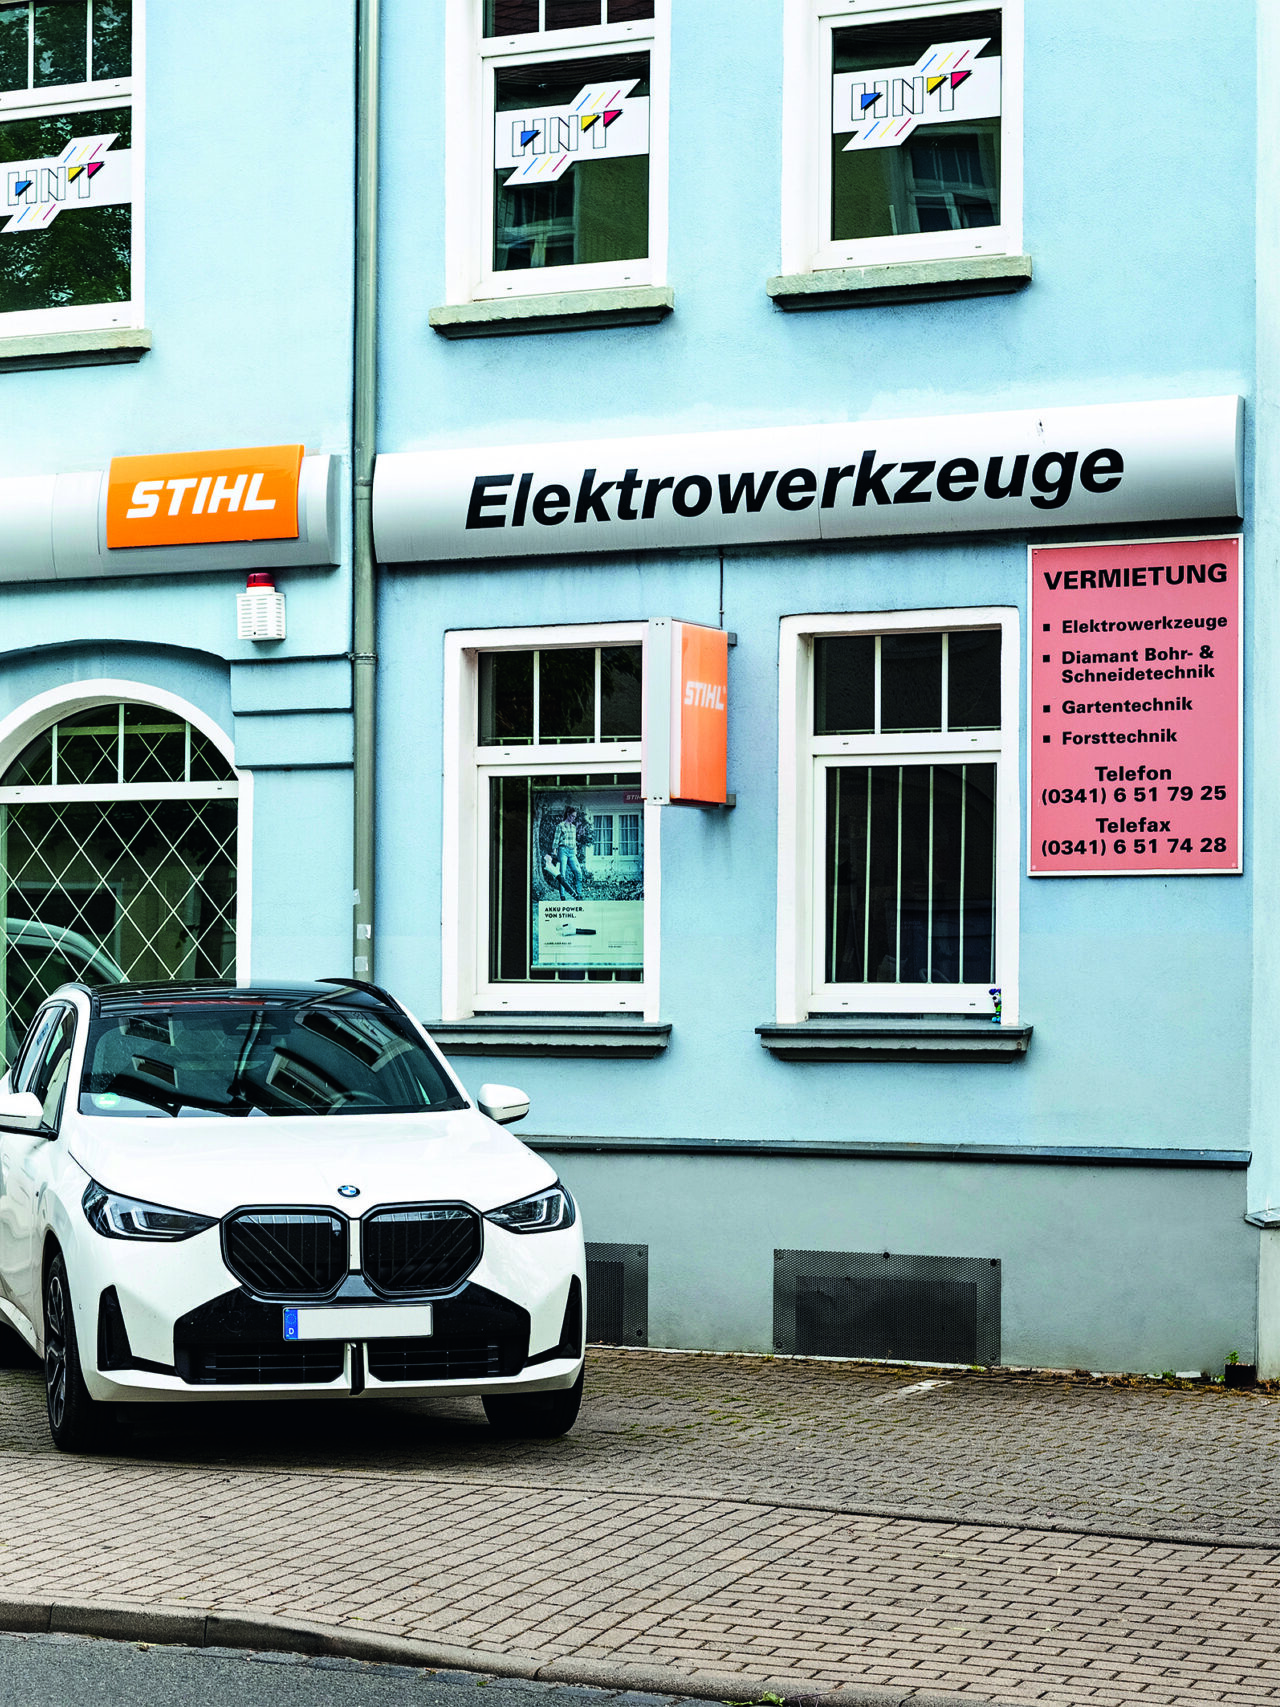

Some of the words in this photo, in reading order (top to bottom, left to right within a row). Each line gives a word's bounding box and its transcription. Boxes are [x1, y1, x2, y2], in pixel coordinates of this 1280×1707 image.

[126, 473, 276, 519] STIHL
[465, 447, 1124, 530] Elektrowerkzeuge
[1043, 563, 1228, 590] VERMIETUNG
[1062, 616, 1228, 634] Elektrowerkzeuge
[1062, 649, 1139, 665] Diamant
[1145, 647, 1194, 662] Bohr-
[1199, 645, 1214, 659] &
[1061, 664, 1215, 683] Schneidetechnik
[684, 681, 724, 711] STIHL
[1062, 697, 1193, 715] Gartentechnik
[1062, 729, 1178, 745] Forsttechnik
[1094, 765, 1172, 781] Telefon
[1041, 787, 1107, 805] (0341)
[1113, 788, 1127, 803] 6
[1133, 787, 1158, 803] 51
[1167, 786, 1194, 801] 79
[1200, 785, 1227, 801] 25
[1096, 817, 1171, 833] Telefax
[1041, 839, 1107, 857] (0341)
[1113, 840, 1127, 855] 6
[1133, 839, 1158, 855] 51
[1167, 838, 1194, 854] 74
[1199, 837, 1227, 853] 28
[288, 1327, 295, 1335] D
